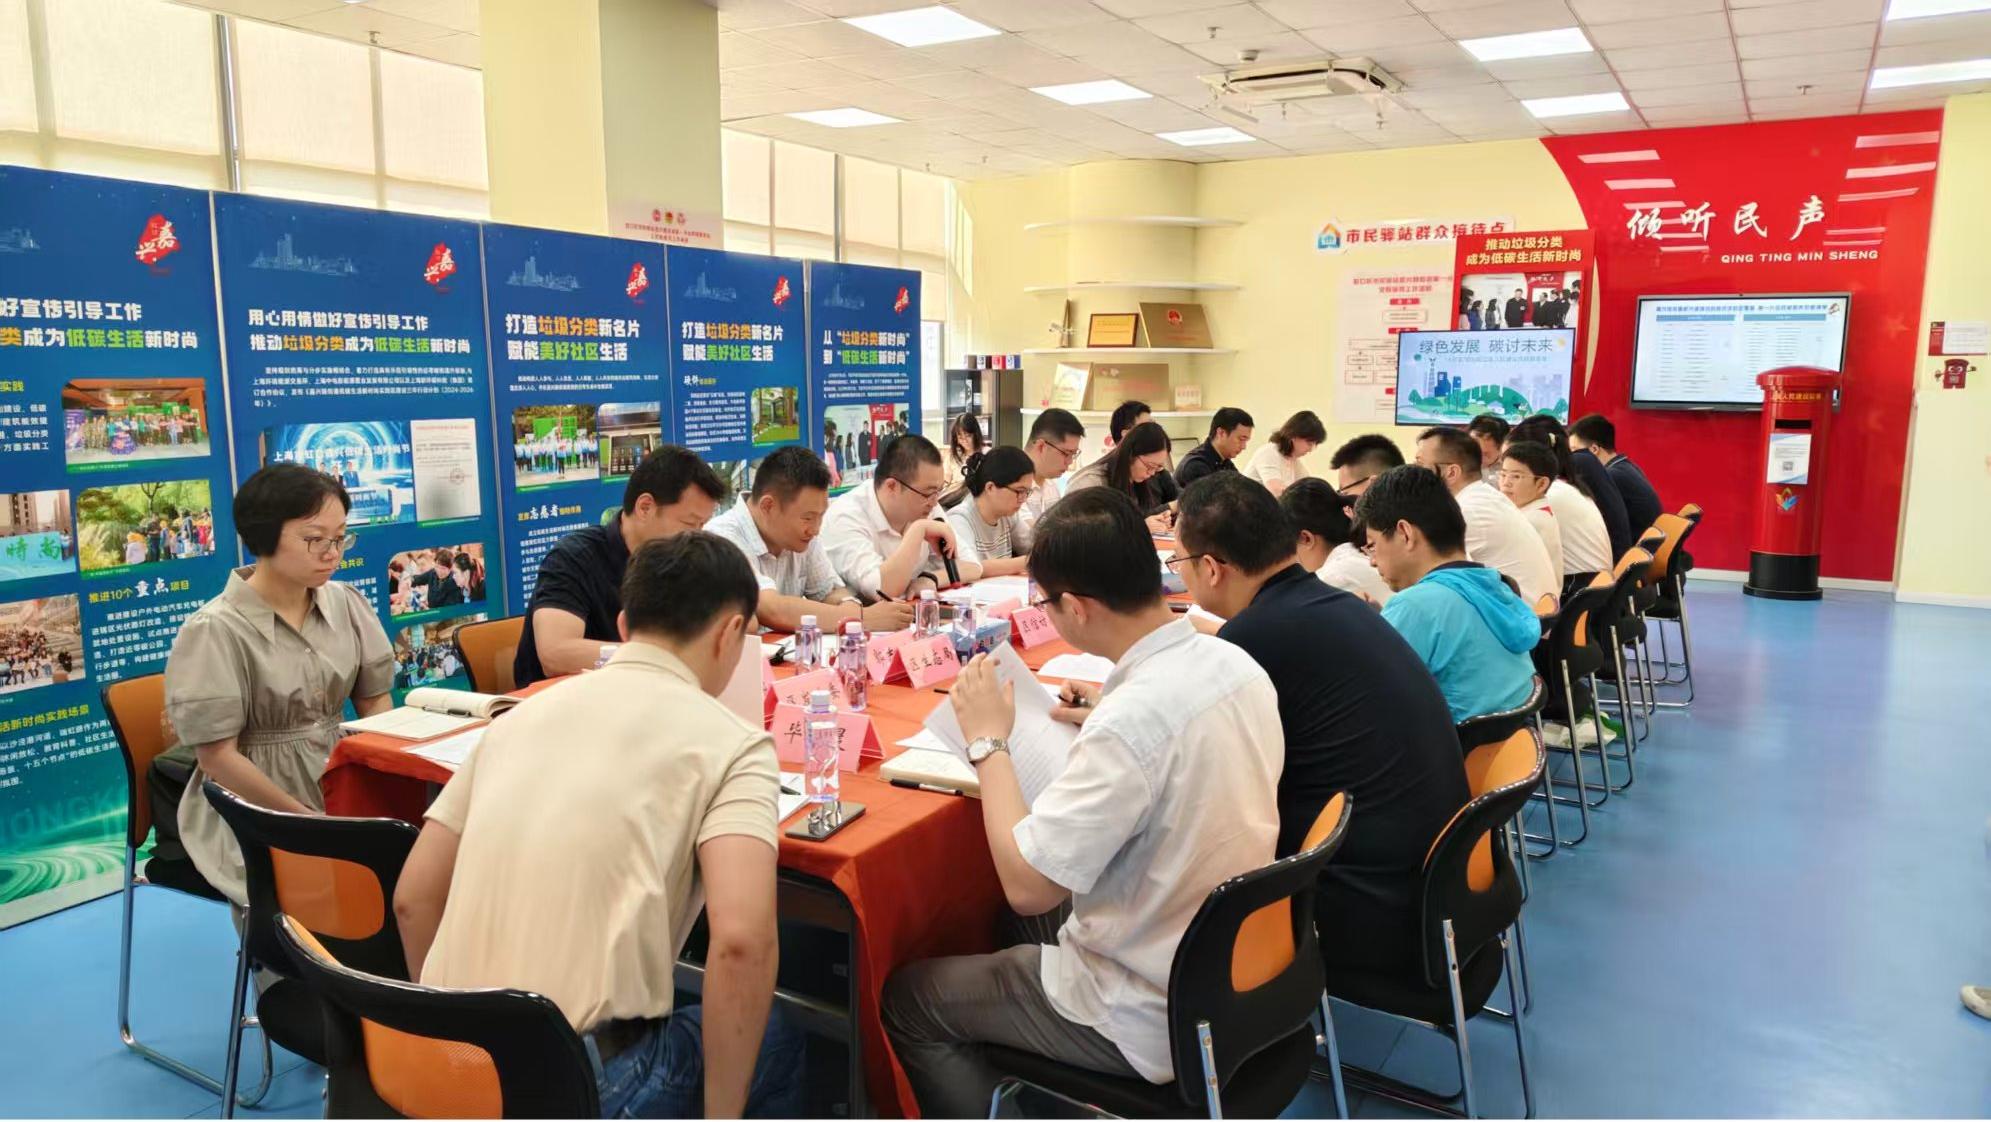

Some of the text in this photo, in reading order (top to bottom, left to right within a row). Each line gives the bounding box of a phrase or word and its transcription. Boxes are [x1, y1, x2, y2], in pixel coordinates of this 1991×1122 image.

[1627, 195, 1826, 241] 倾听民声
[1485, 236, 1563, 251] 推动垃圾分类
[1466, 249, 1582, 266] 成为低碳生活新时尚
[1721, 250, 1878, 264] QING TING MIN SHENG
[0, 298, 142, 321] 好宣传引导工作
[248, 309, 429, 332] 用心用情做好宣传引导工作
[505, 314, 640, 338] 打造垃圾分类新名片
[0, 327, 198, 349] 类成为低碳生活新时尚
[682, 321, 784, 342] 打造垃圾分类新名片
[250, 334, 470, 354] 推动垃圾分类成为低碳生活新时尚
[507, 340, 628, 362] 赋能美好社区生活
[683, 344, 774, 362] 赋能美好社区生活
[1420, 337, 1553, 354] 绿色发展 碳讨未来
